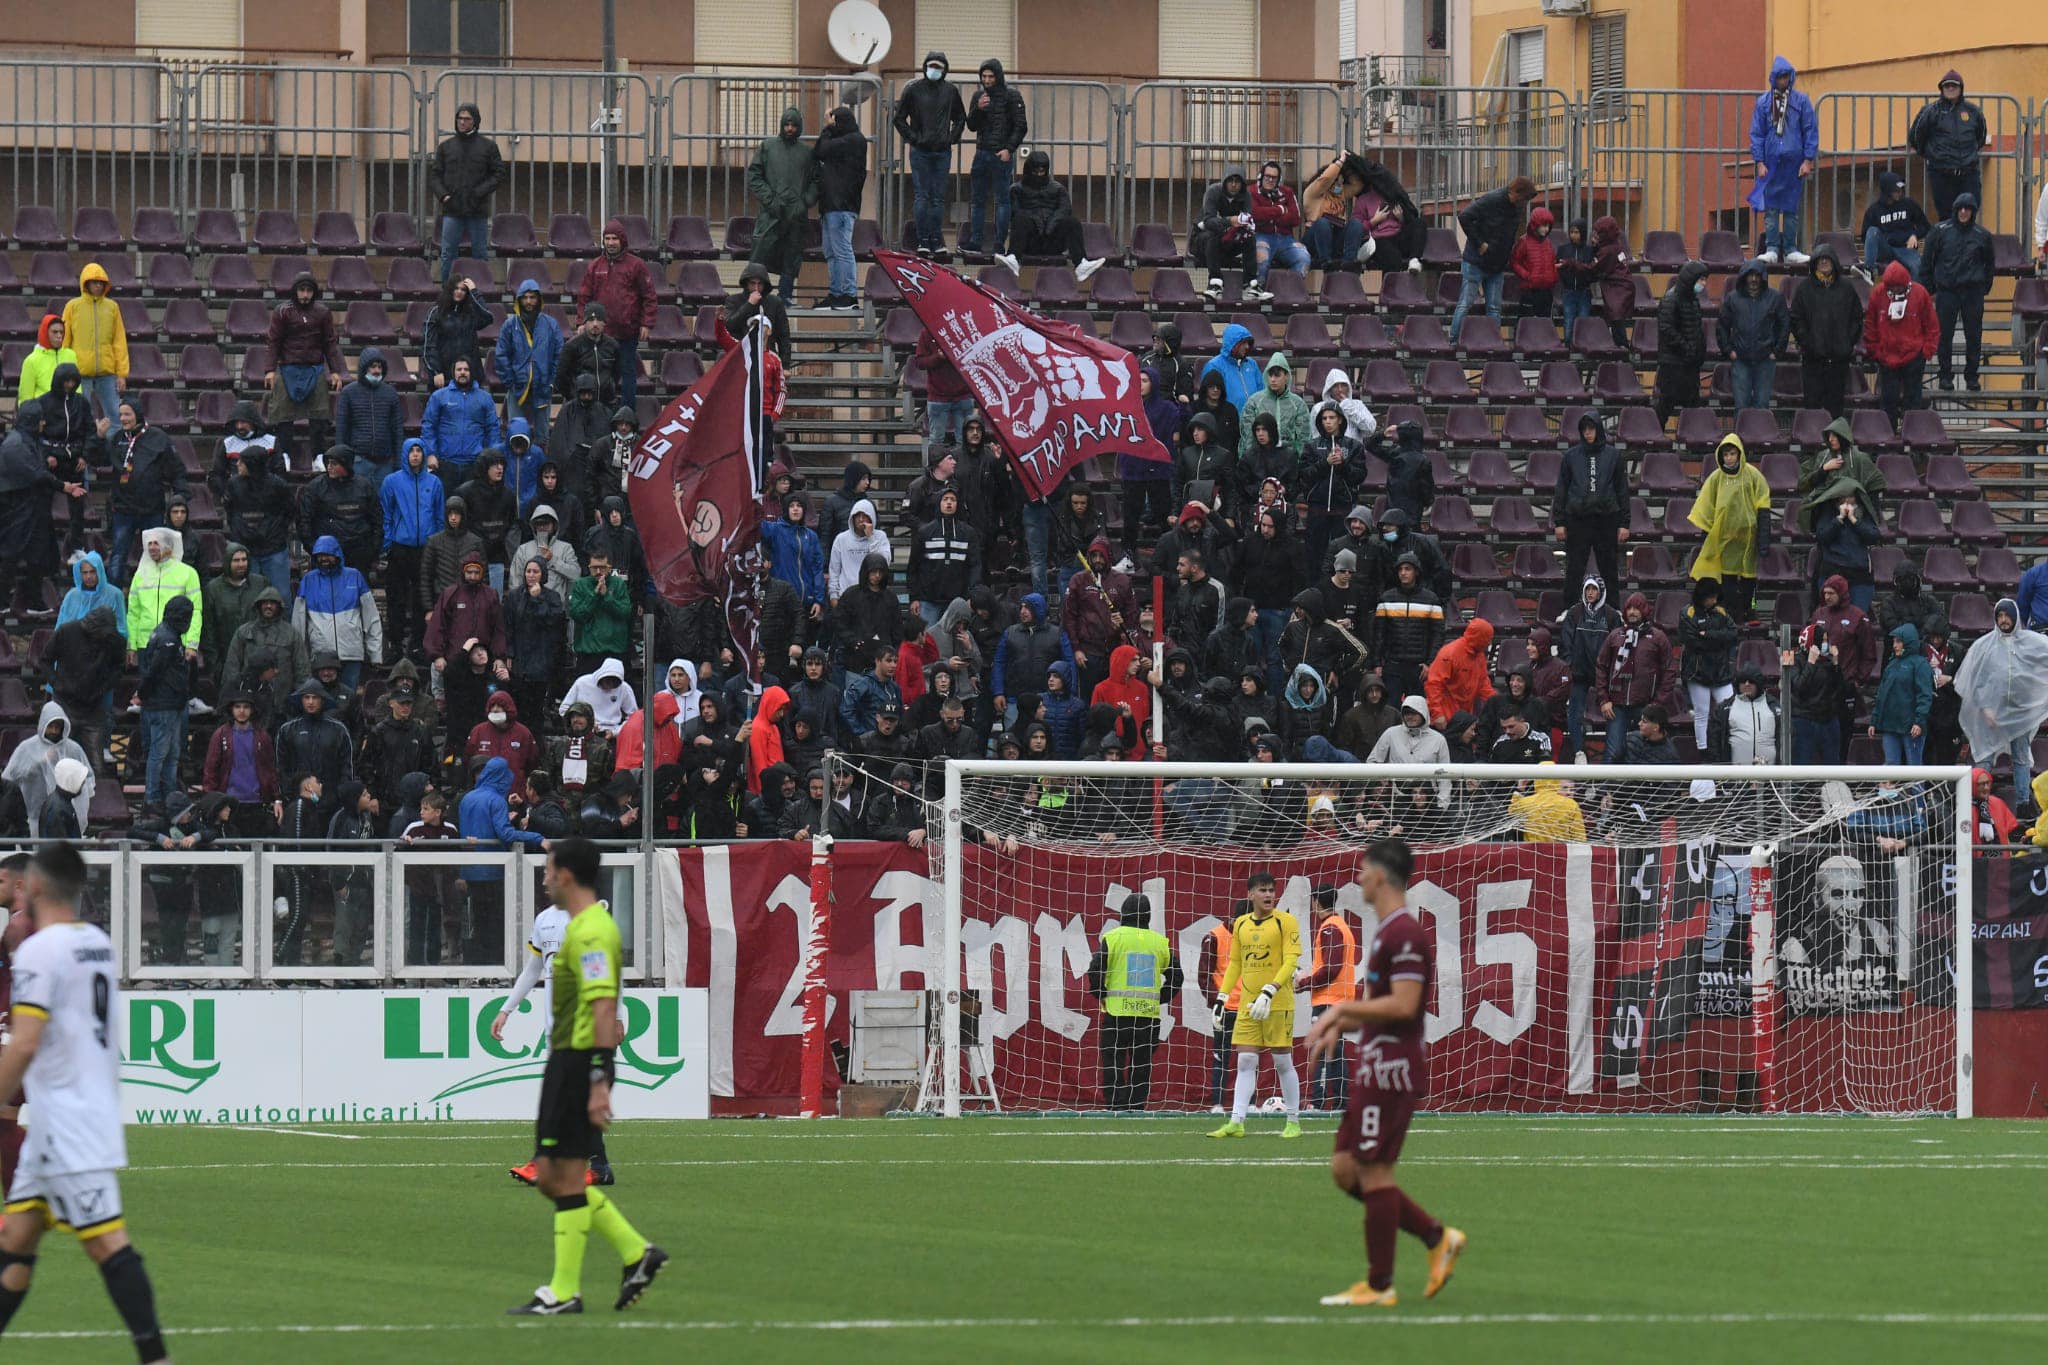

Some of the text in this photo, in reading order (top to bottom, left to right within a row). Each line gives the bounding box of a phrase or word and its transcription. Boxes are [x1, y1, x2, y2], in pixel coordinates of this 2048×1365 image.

[764, 873, 836, 1036] 2
[1971, 922, 2033, 939] RAPANI
[120, 998, 221, 1079] RI
[384, 995, 685, 1075] LICRI
[136, 1102, 455, 1123] www.autogrulicari.it
[1361, 1106, 1381, 1137] 8
